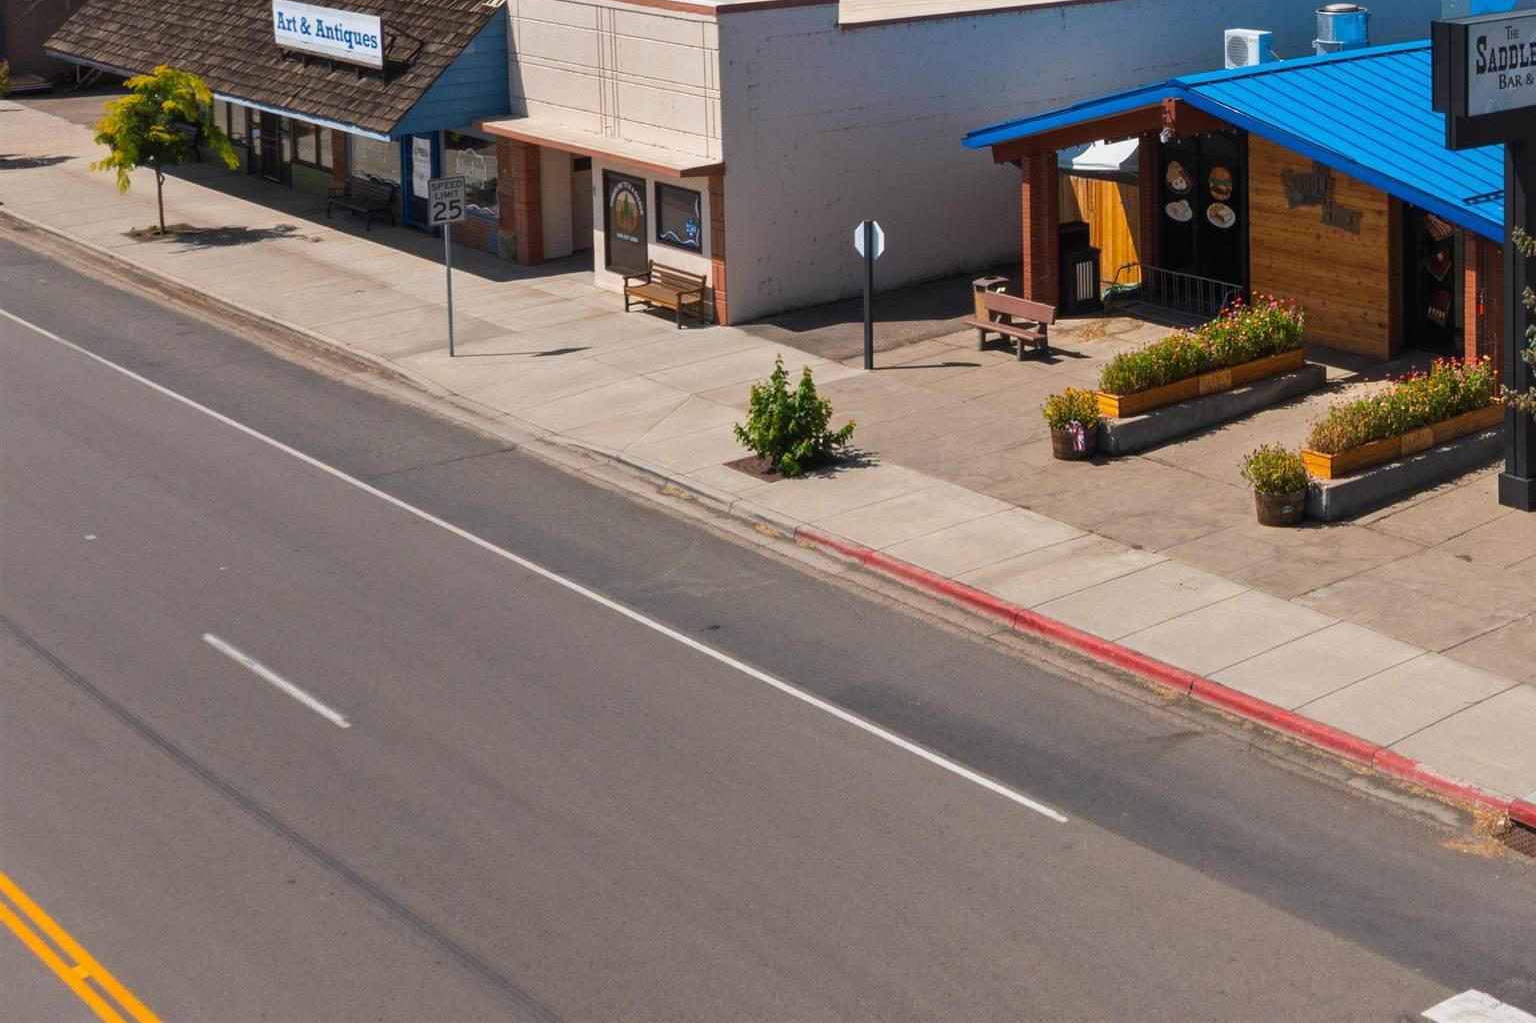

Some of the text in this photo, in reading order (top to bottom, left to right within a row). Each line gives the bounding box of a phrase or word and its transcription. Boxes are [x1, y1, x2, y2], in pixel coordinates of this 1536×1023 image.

[277, 11, 378, 49] Art & Antiques
[1505, 25, 1519, 41] THE
[1498, 73, 1522, 90] BAR
[1526, 73, 1534, 86] &
[432, 181, 462, 191] SPEED
[435, 190, 458, 200] LIMIT
[433, 199, 462, 222] 25
